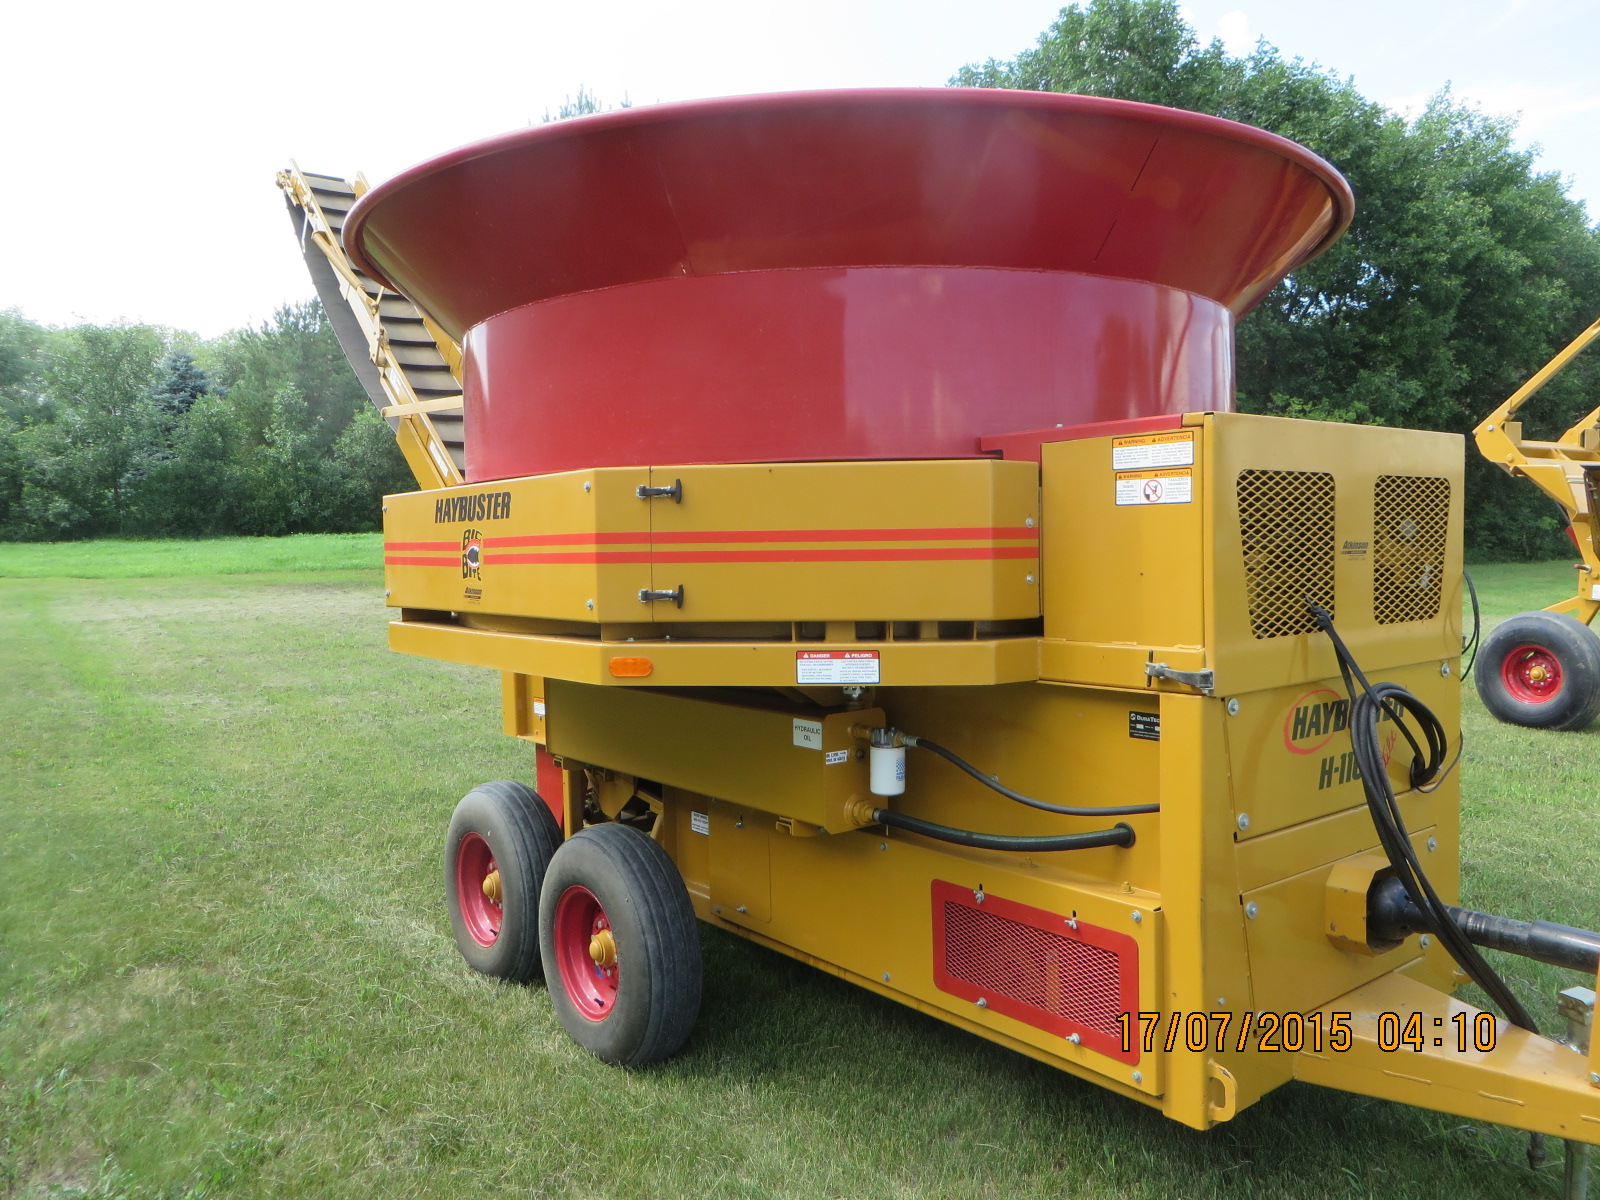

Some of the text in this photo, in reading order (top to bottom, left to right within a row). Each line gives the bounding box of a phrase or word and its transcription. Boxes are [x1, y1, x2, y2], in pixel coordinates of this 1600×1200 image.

[434, 491, 511, 524] HAYBUSTER
[795, 724, 821, 735] HYDRAULIC
[803, 734, 812, 742] OIL
